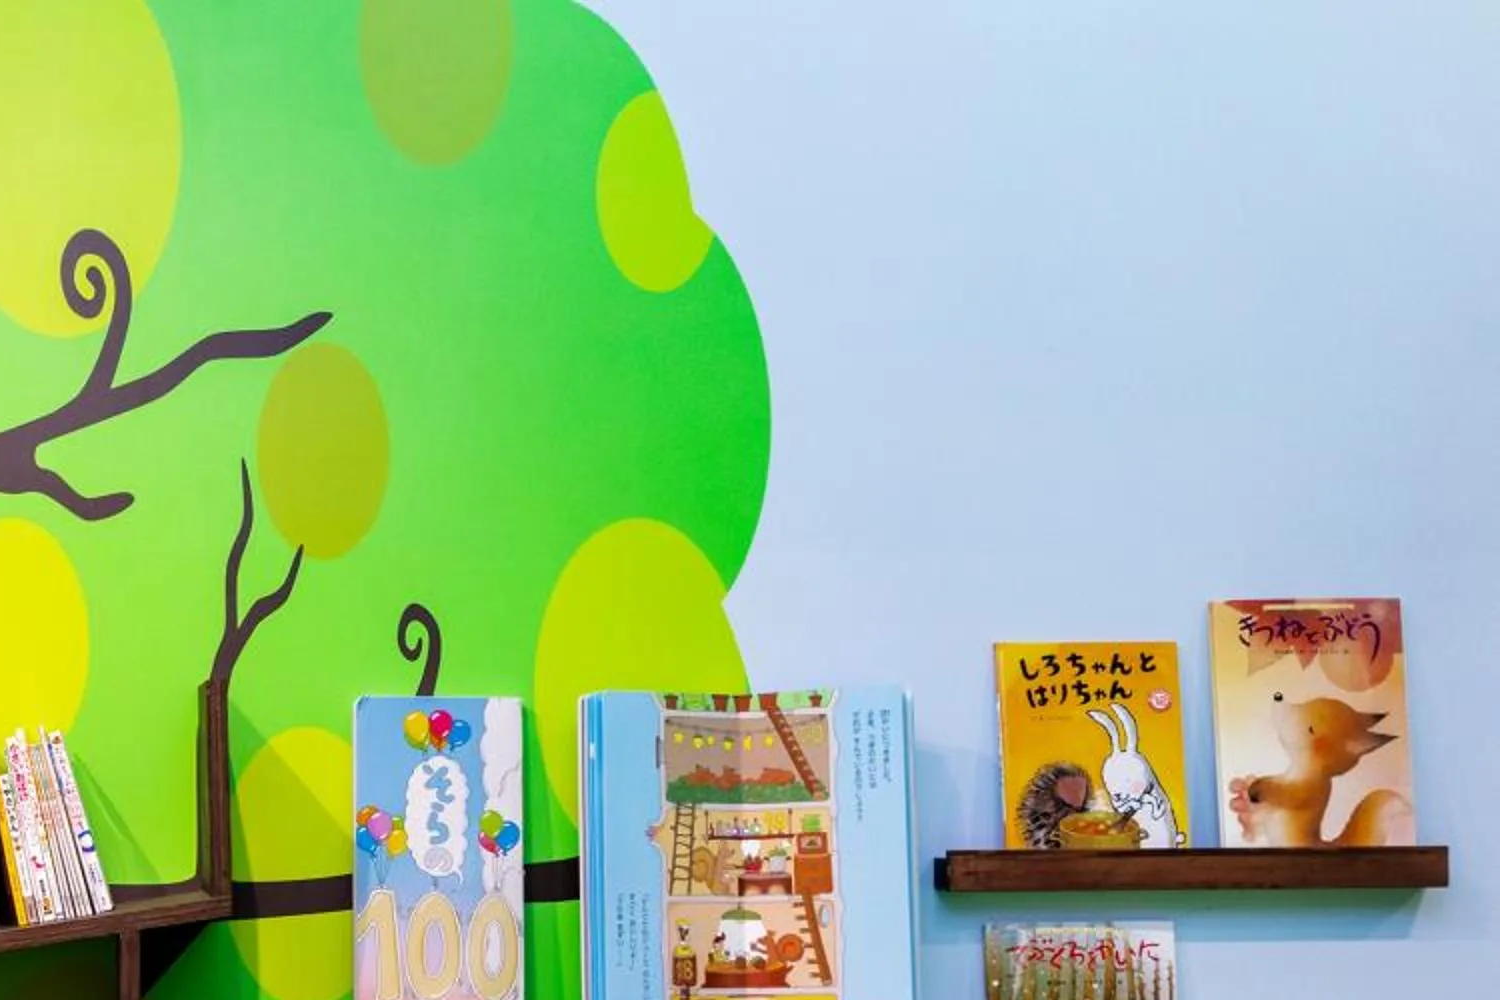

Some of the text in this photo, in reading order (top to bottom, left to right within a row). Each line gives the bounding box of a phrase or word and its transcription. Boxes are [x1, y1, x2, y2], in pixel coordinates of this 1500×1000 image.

[1238, 612, 1382, 664] きつねとぶどう
[1019, 651, 1157, 682] しろちゃんと
[1028, 679, 1133, 709] はりちゃん
[422, 763, 457, 874] そらの
